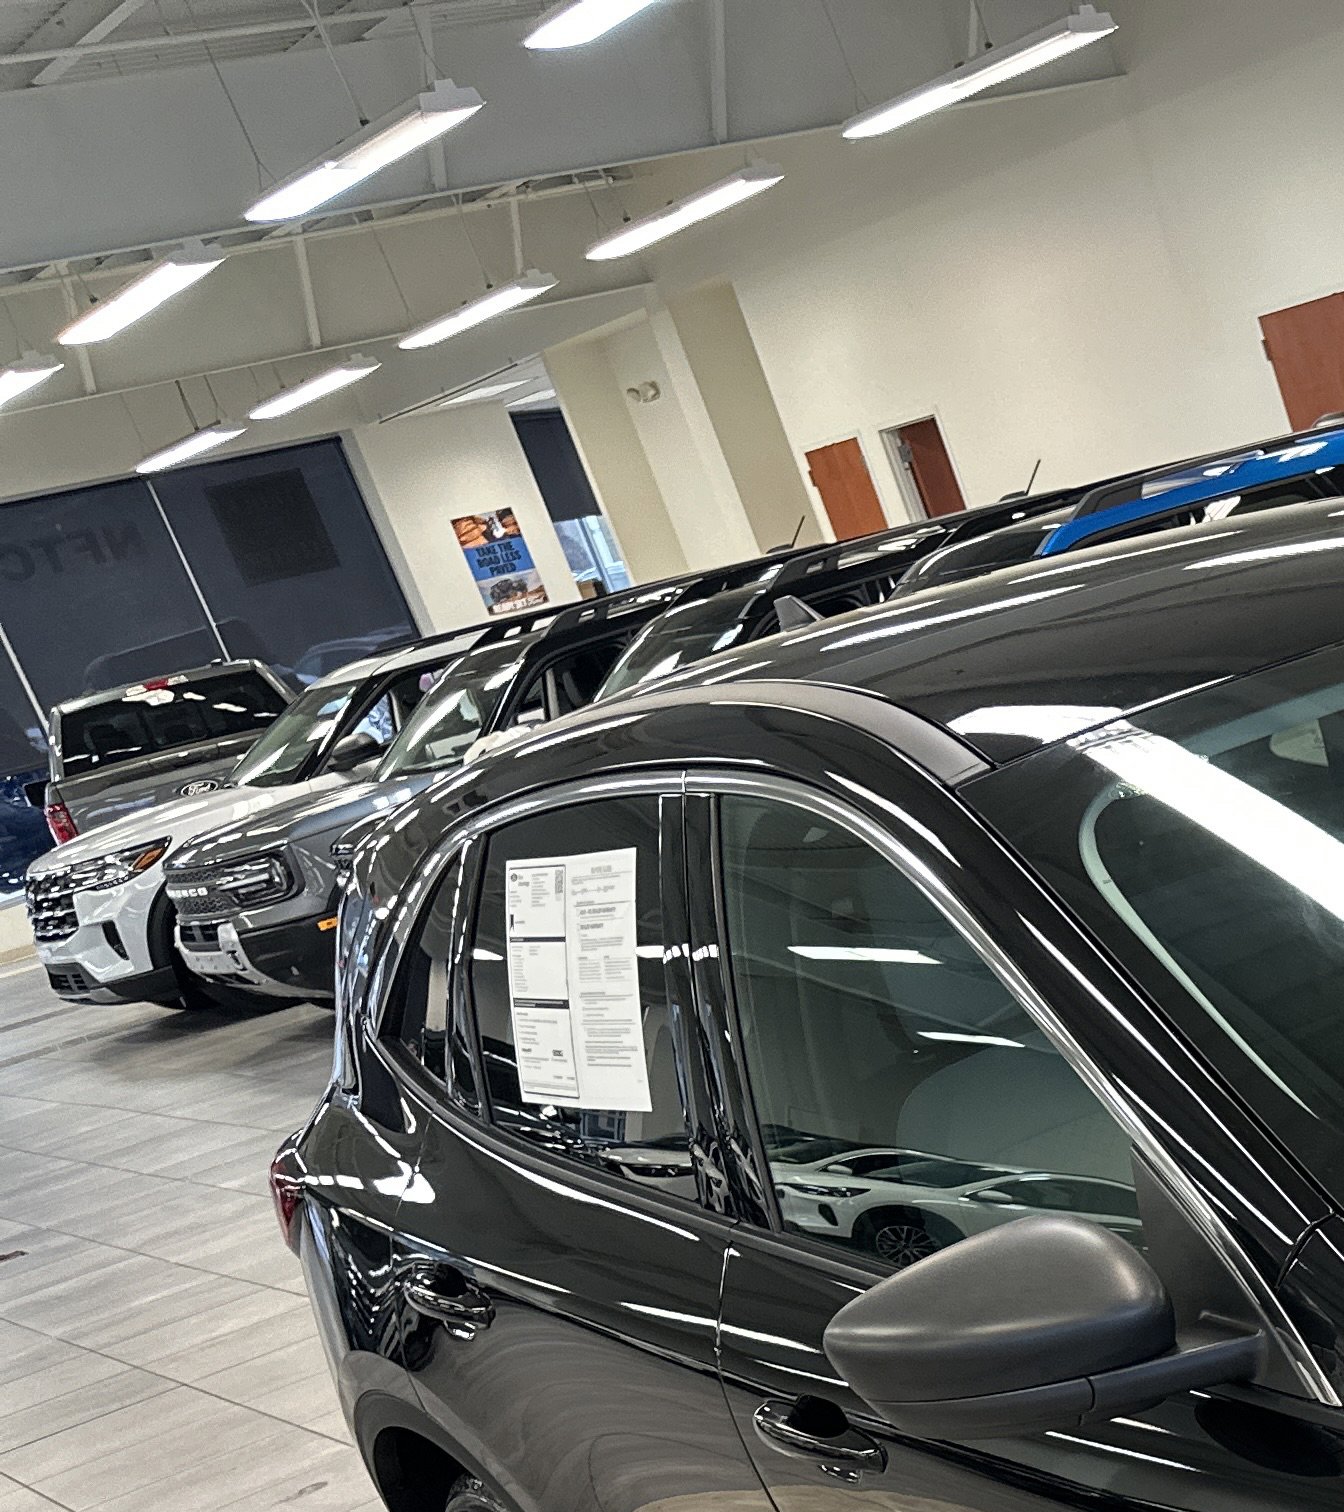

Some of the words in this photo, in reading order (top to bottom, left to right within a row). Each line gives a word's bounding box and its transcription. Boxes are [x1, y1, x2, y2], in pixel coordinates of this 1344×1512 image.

[476, 545, 498, 557] TAKE
[498, 541, 514, 552] THE
[478, 556, 500, 568] ROAD
[501, 551, 522, 562] LESS
[489, 563, 517, 576] PAVED
